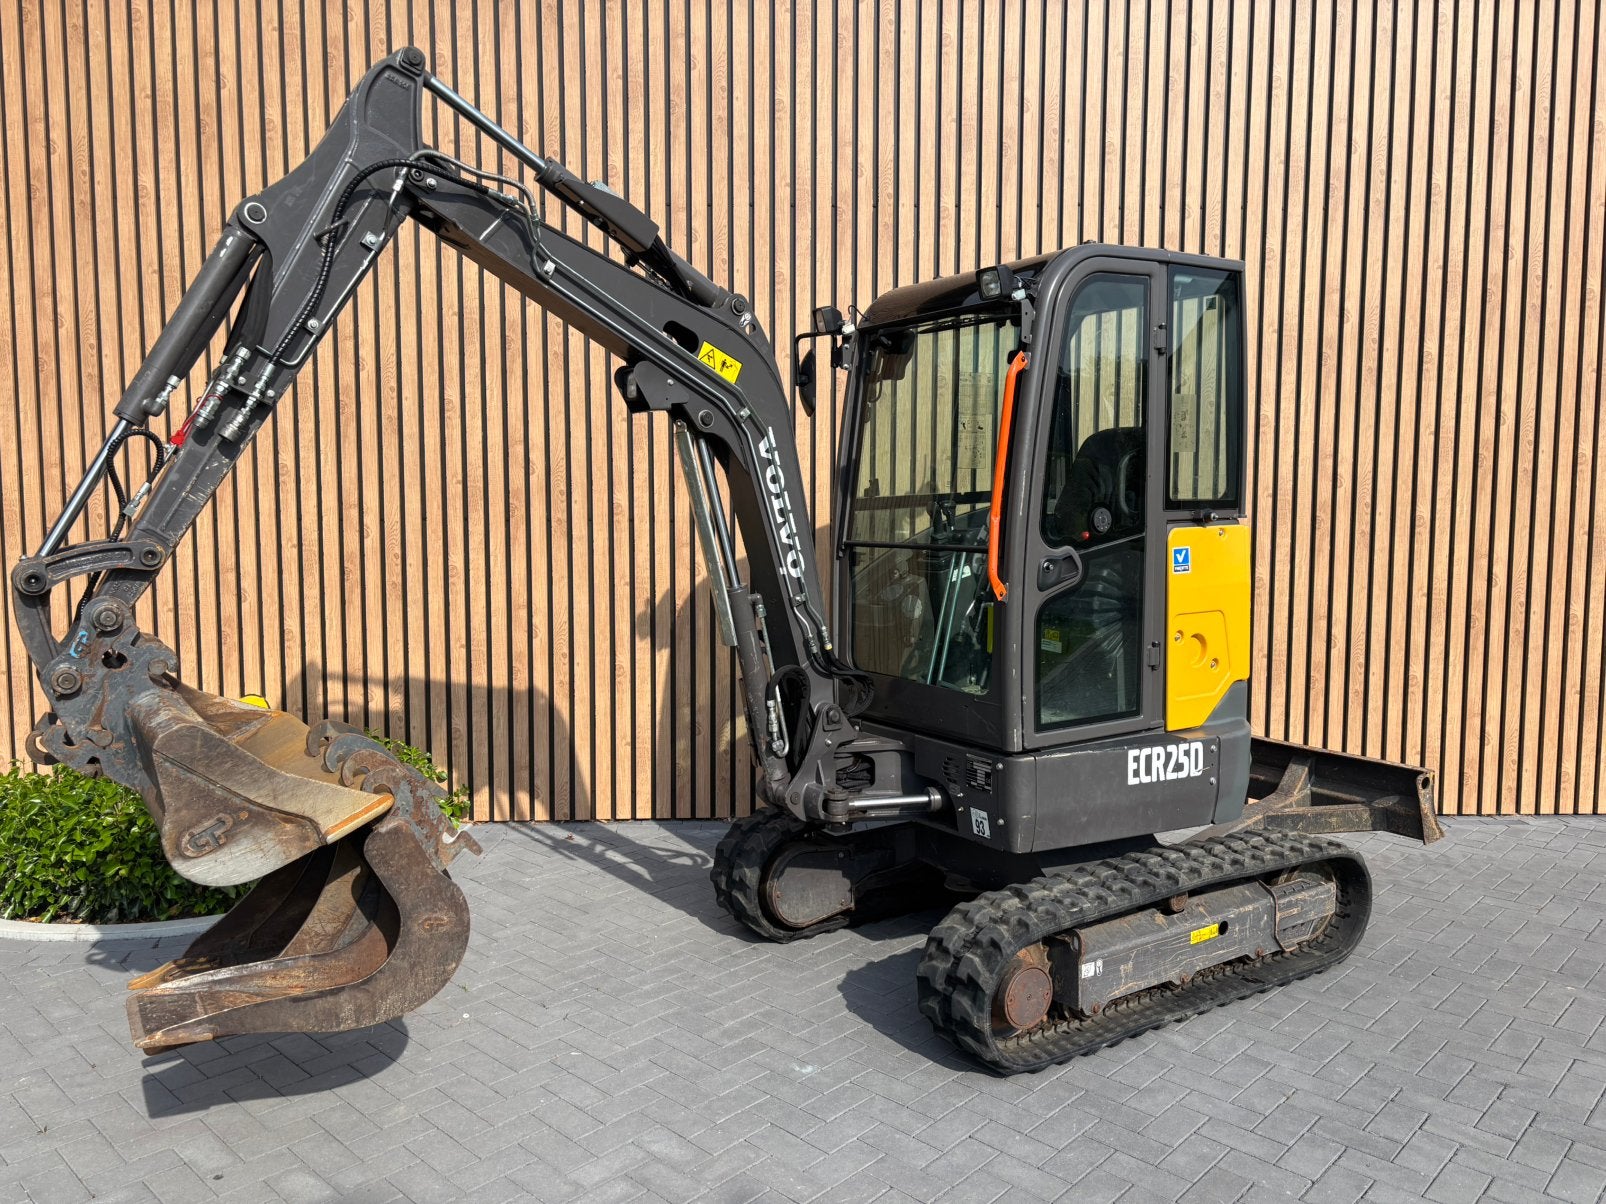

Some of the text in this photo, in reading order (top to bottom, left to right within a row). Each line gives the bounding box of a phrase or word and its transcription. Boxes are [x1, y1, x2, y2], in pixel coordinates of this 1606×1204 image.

[758, 426, 806, 579] VOLVO
[1127, 741, 1204, 786] ECR25D
[975, 818, 986, 836] 93
